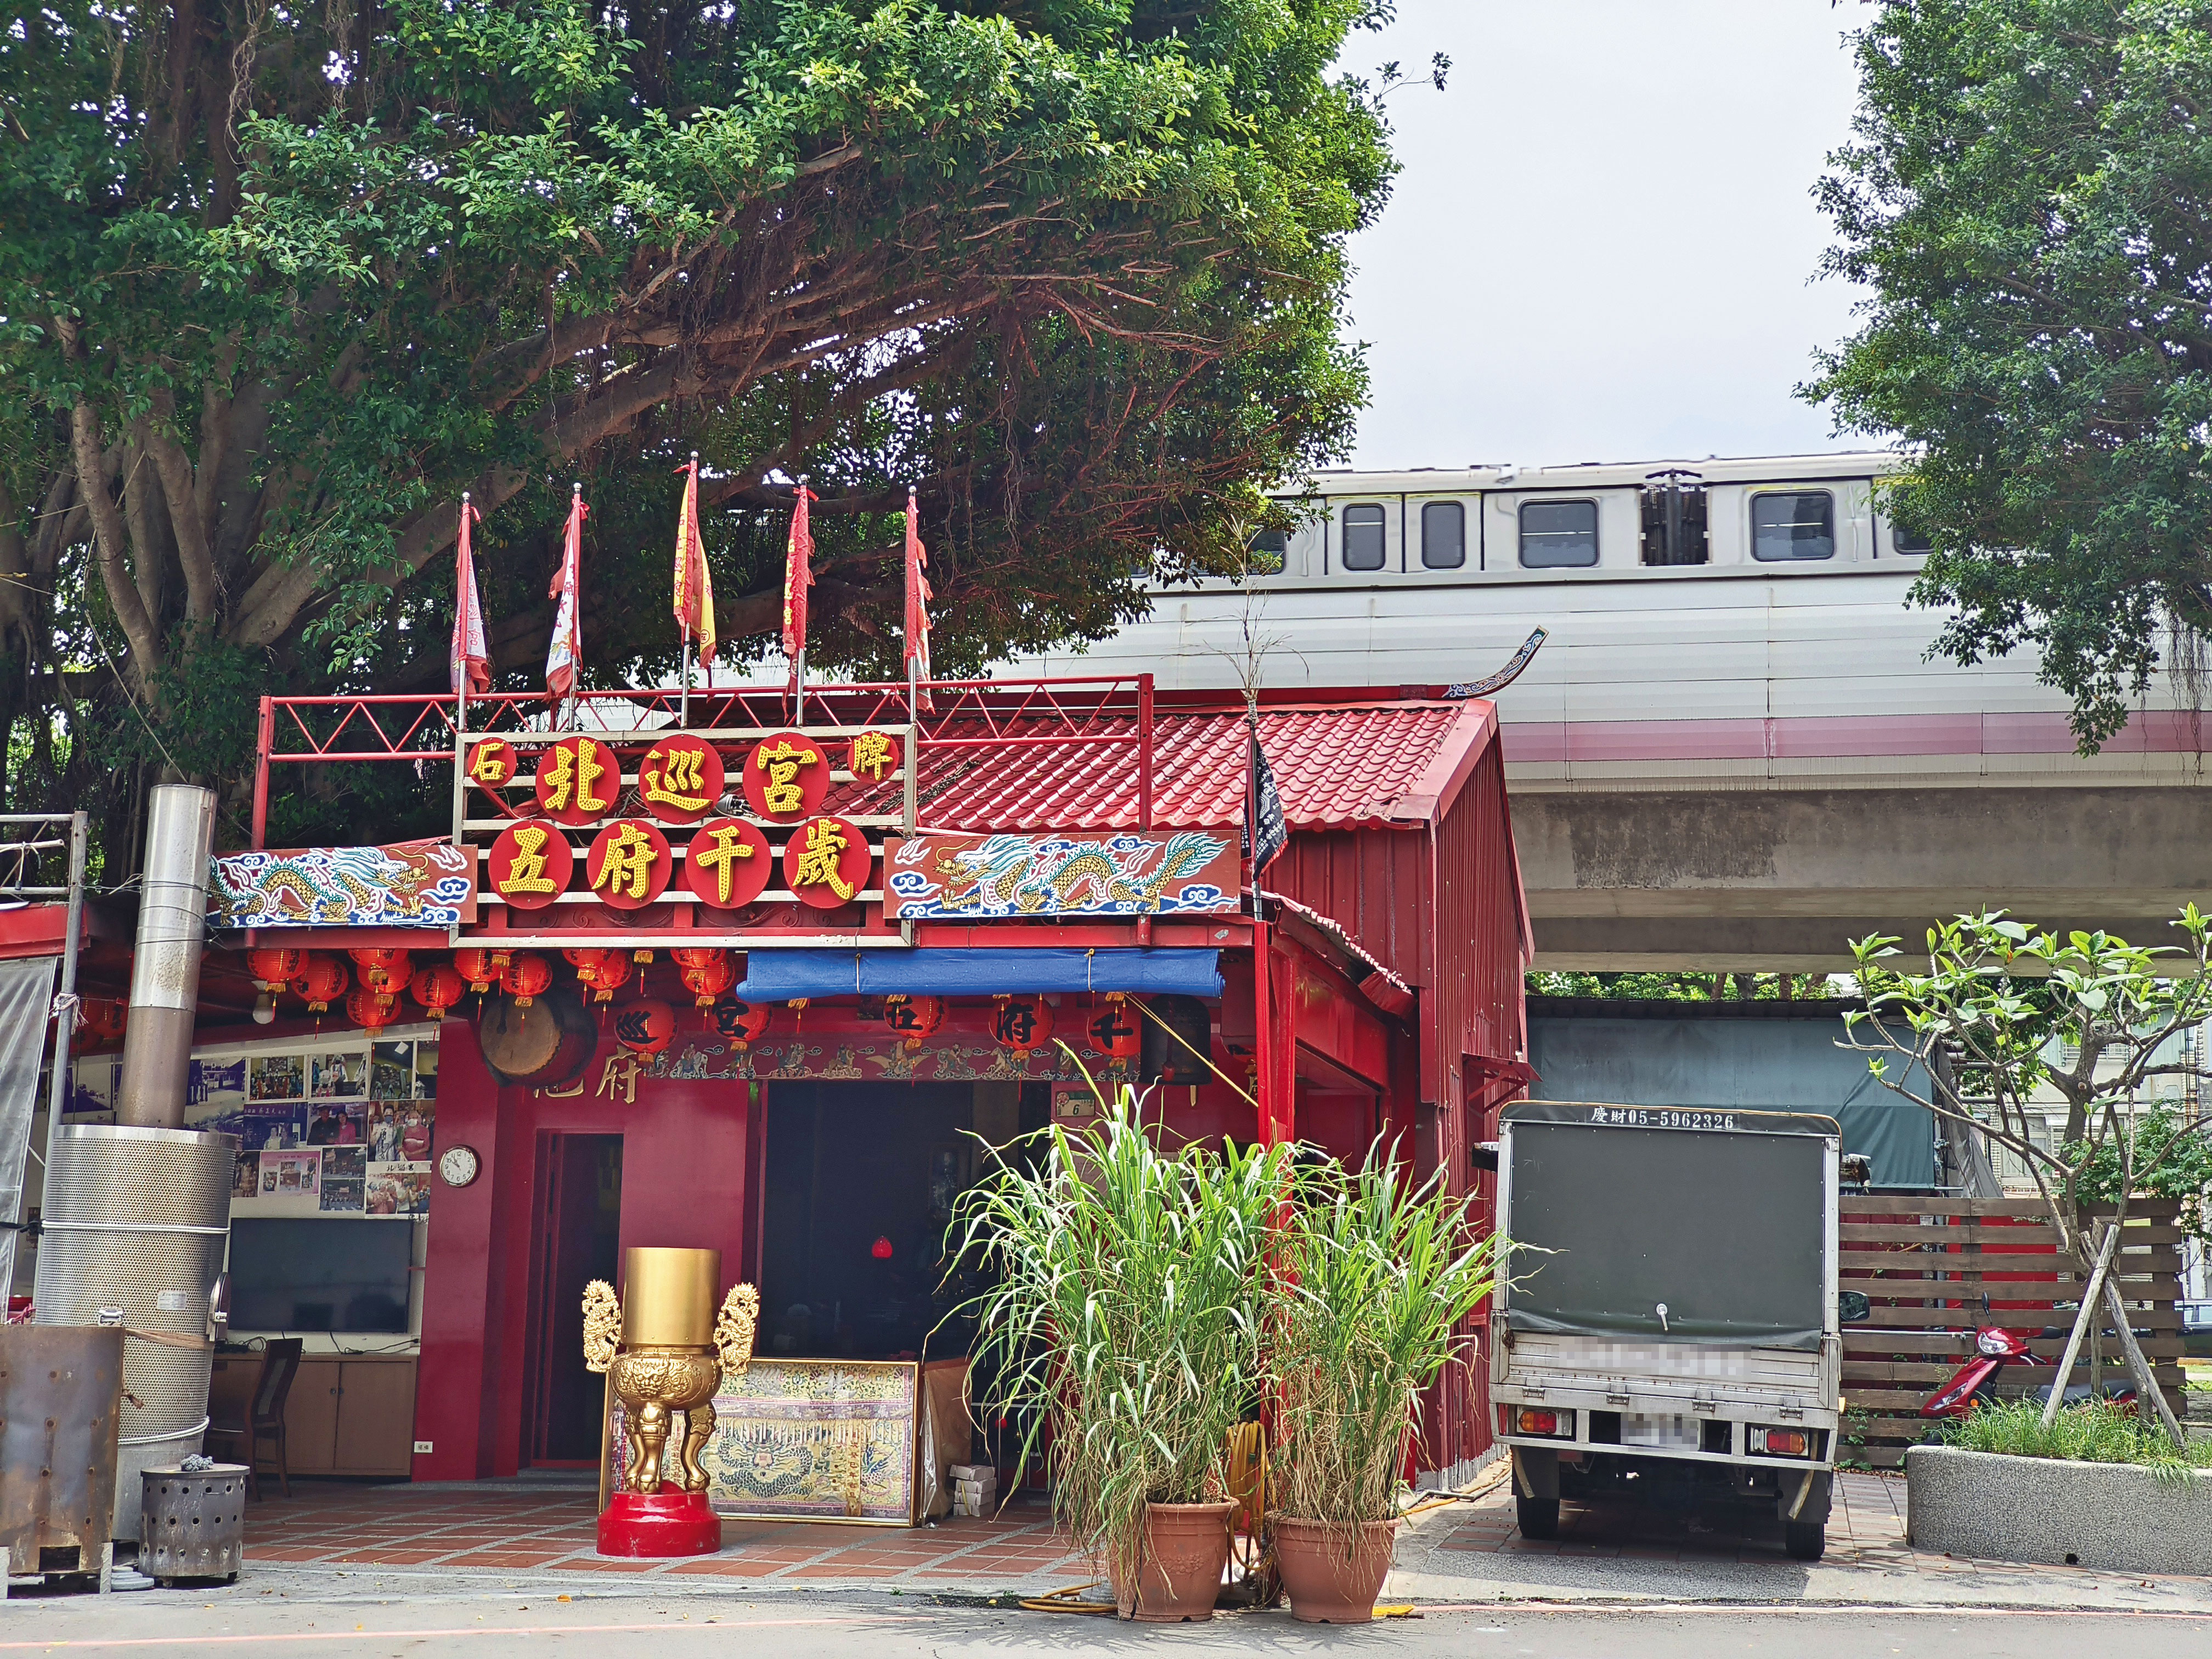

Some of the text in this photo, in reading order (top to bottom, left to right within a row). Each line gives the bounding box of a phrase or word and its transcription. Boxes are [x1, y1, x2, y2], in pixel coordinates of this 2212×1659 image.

[499, 816, 854, 903] 五府千歲
[1090, 1011, 1134, 1049] 千
[1073, 1104, 1080, 1115] 6
